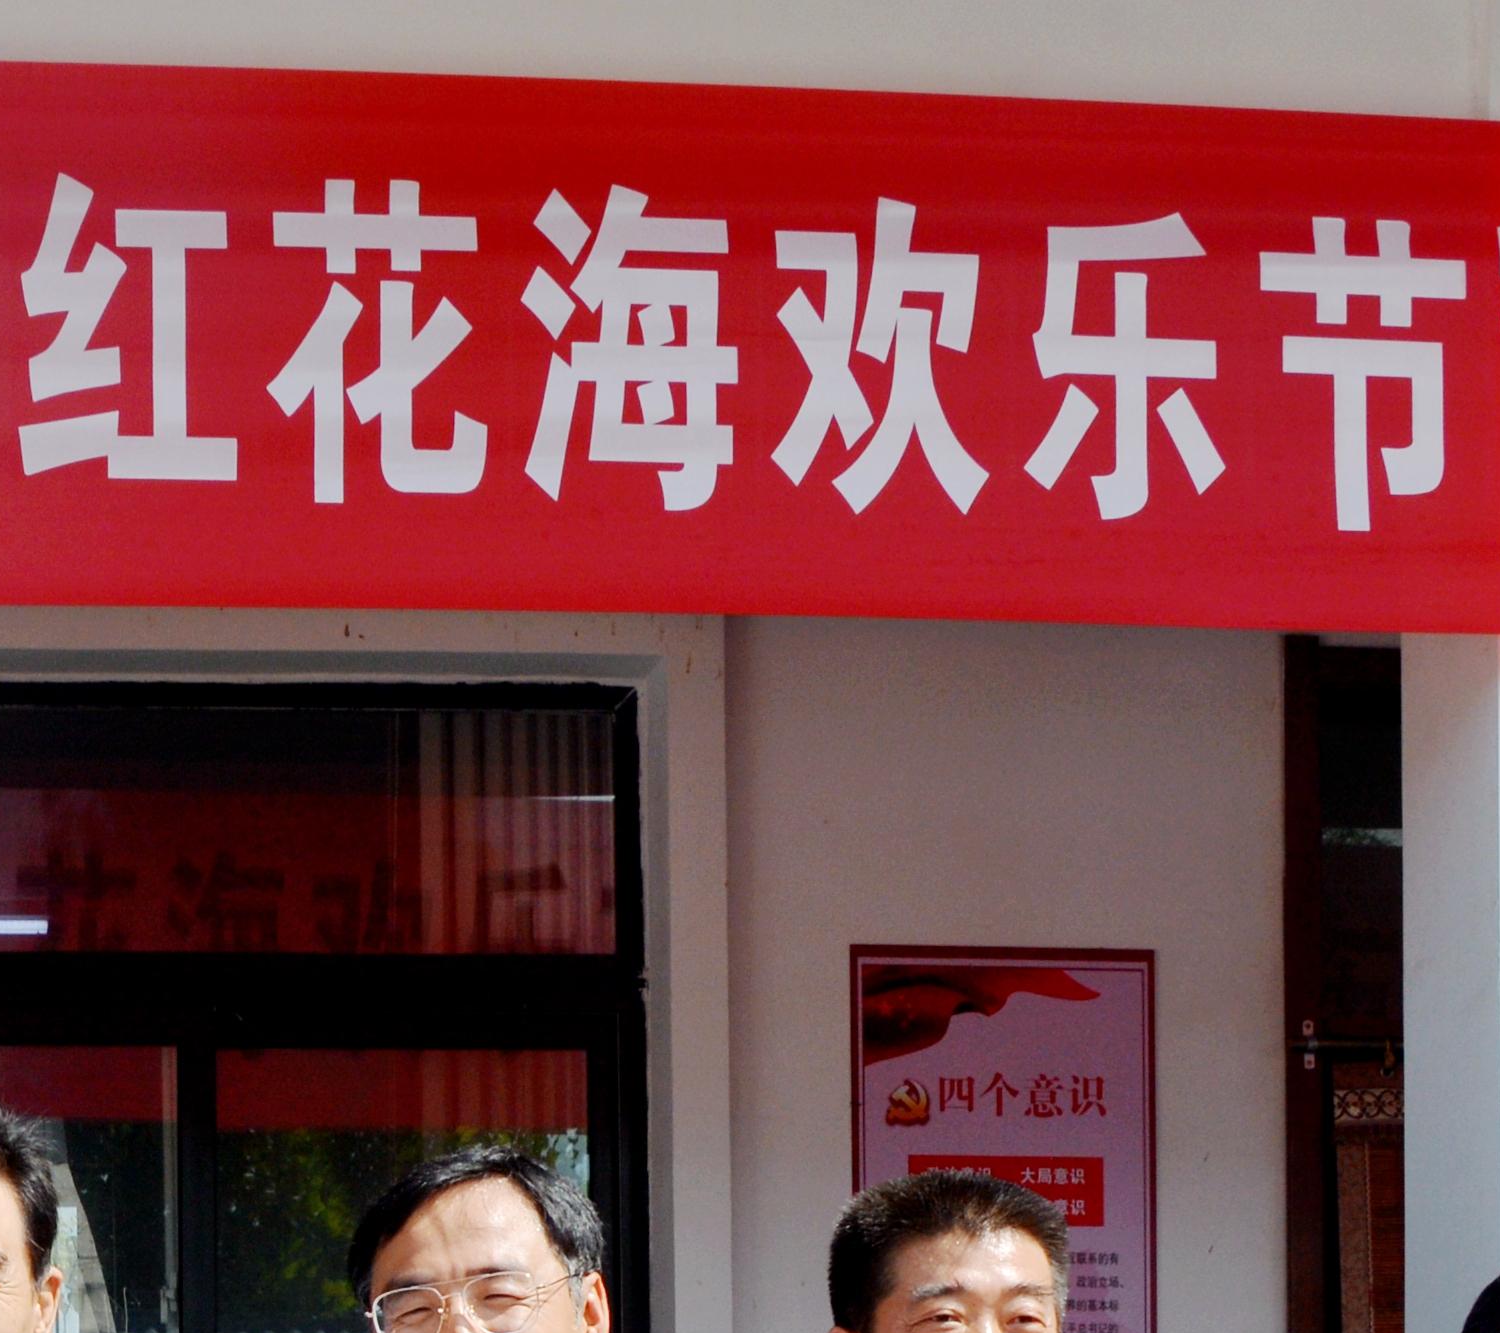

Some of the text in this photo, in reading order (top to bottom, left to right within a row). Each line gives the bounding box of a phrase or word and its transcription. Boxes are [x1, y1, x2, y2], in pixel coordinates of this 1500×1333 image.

[939, 1072, 1108, 1118] 四个意识
[1020, 1167, 1085, 1184] 大局意识
